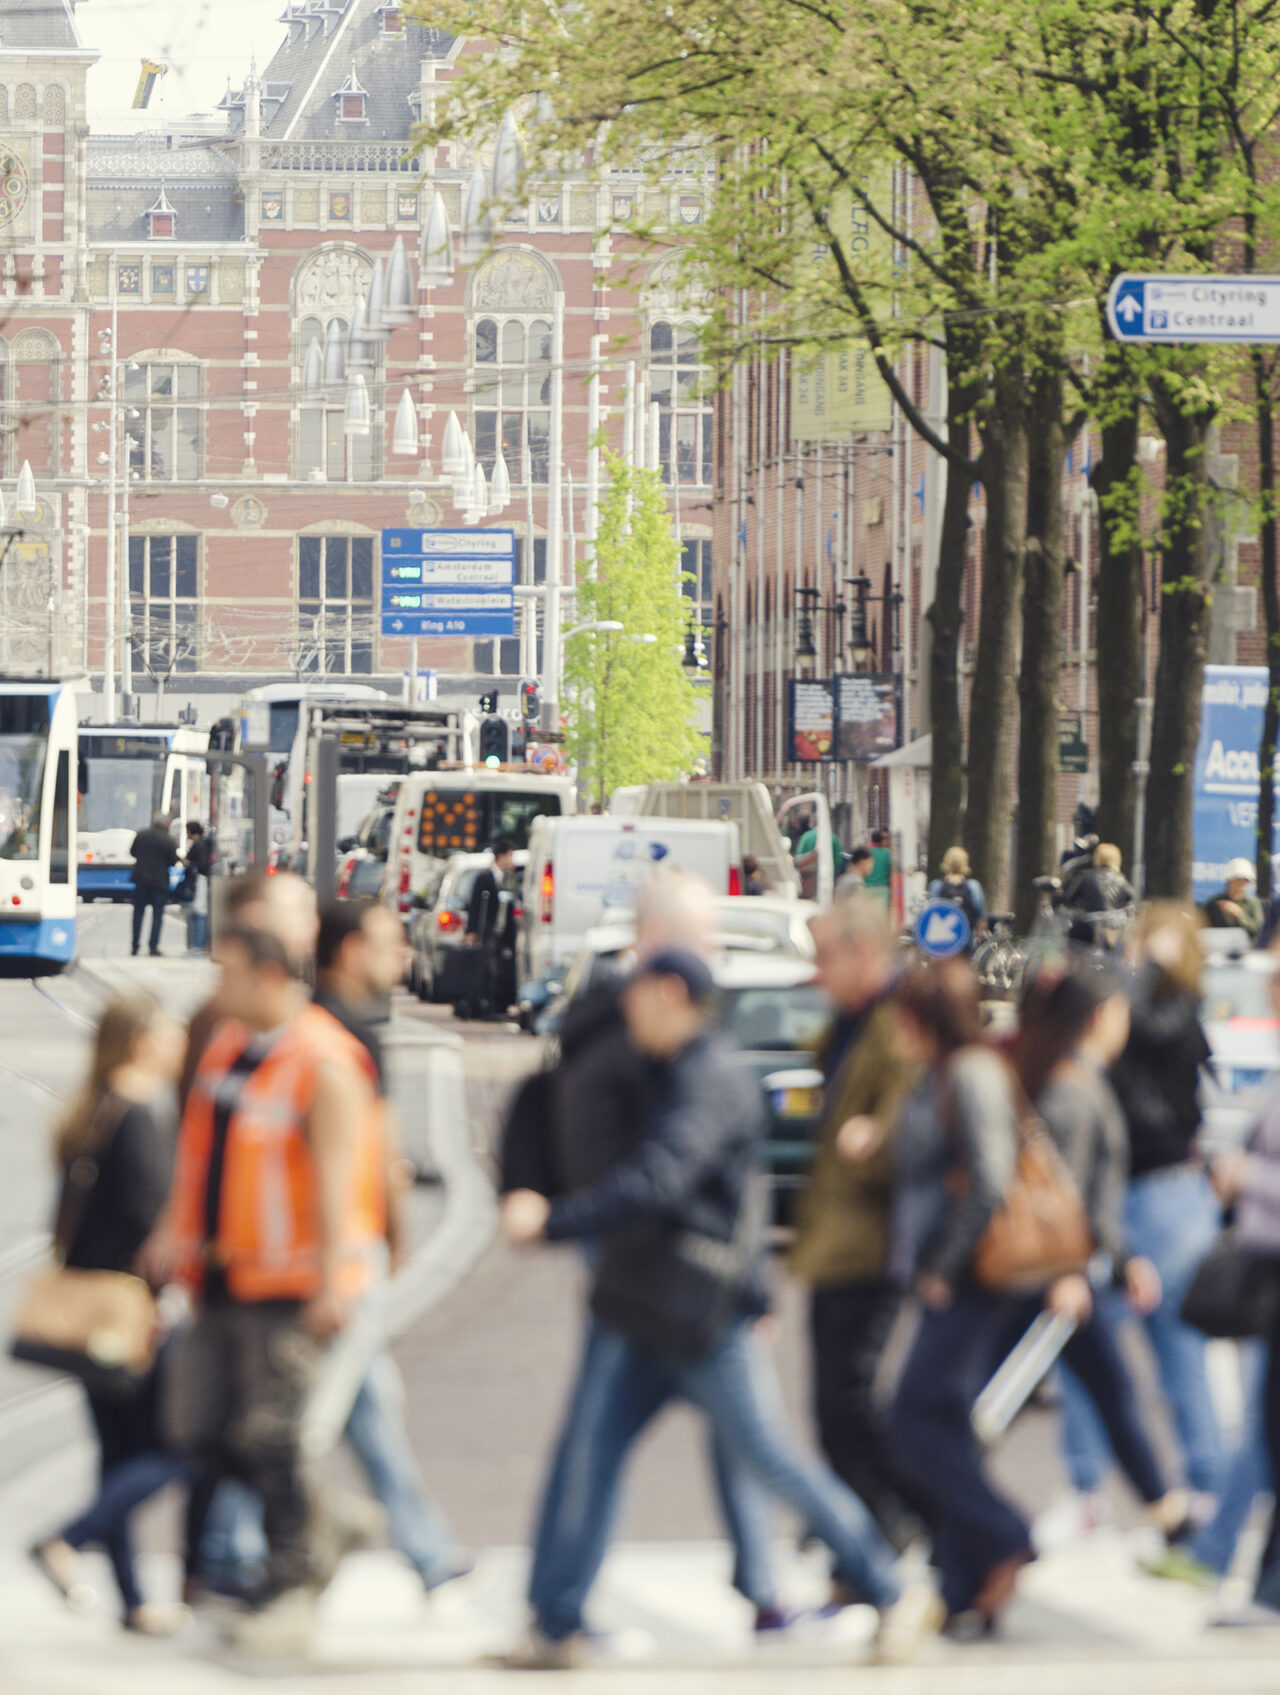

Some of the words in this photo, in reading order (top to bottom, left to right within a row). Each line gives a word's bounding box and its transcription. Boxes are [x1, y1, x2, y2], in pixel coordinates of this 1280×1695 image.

[1192, 287, 1267, 306] Cityring
[1174, 312, 1254, 327] Centraal
[421, 620, 444, 633] Ring
[446, 620, 466, 631] A10
